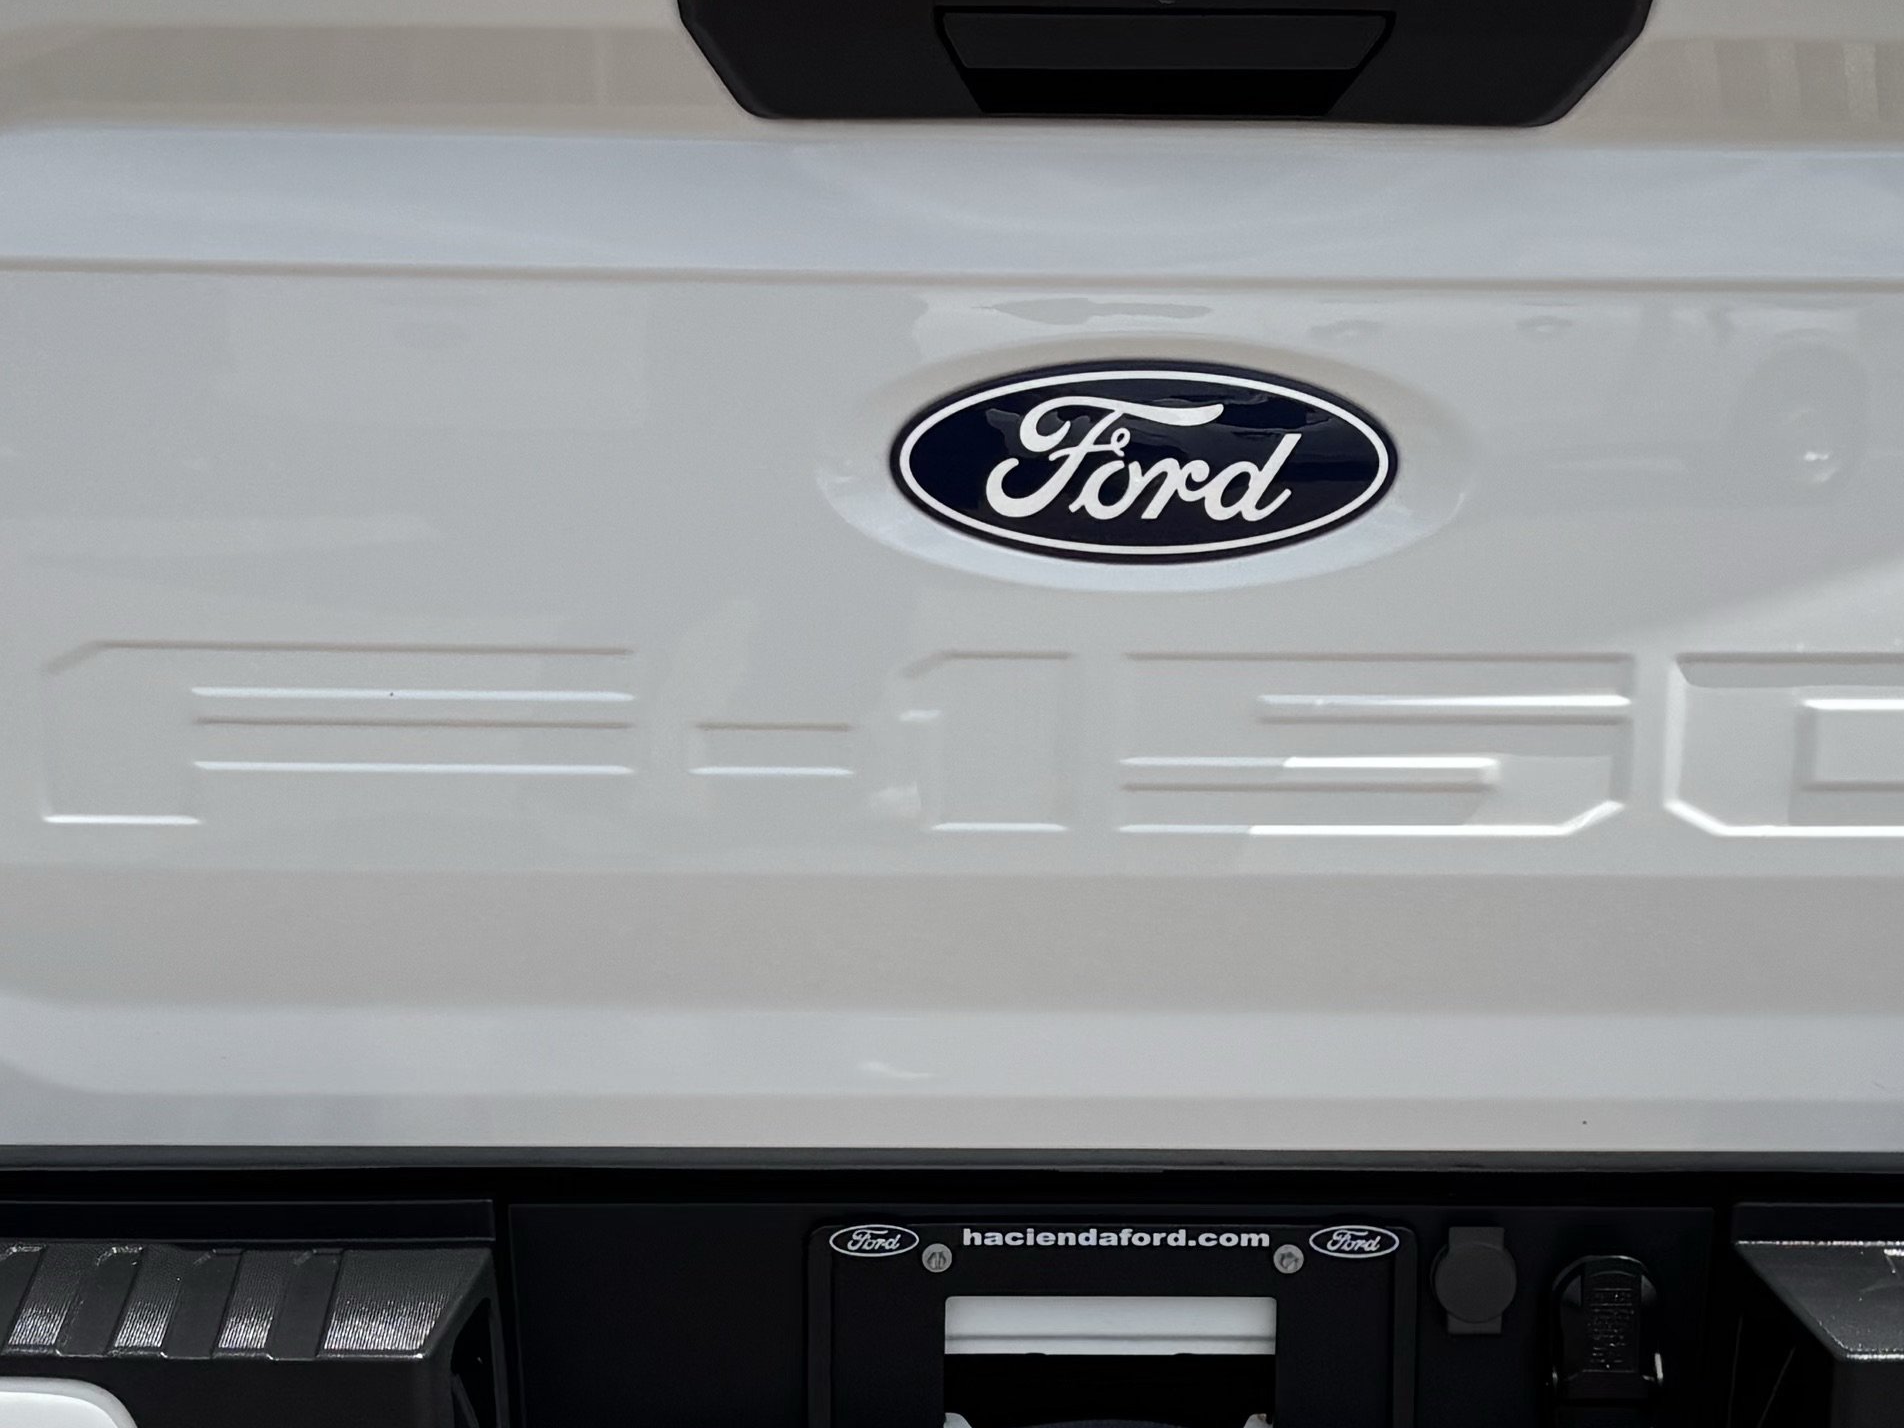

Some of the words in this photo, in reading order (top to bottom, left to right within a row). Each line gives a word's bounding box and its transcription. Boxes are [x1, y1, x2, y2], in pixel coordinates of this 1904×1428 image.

[986, 396, 1302, 522] Ford
[847, 1229, 902, 1251] Ford
[962, 1228, 1270, 1247] haciendaford.com
[1326, 1229, 1381, 1251] Ford
